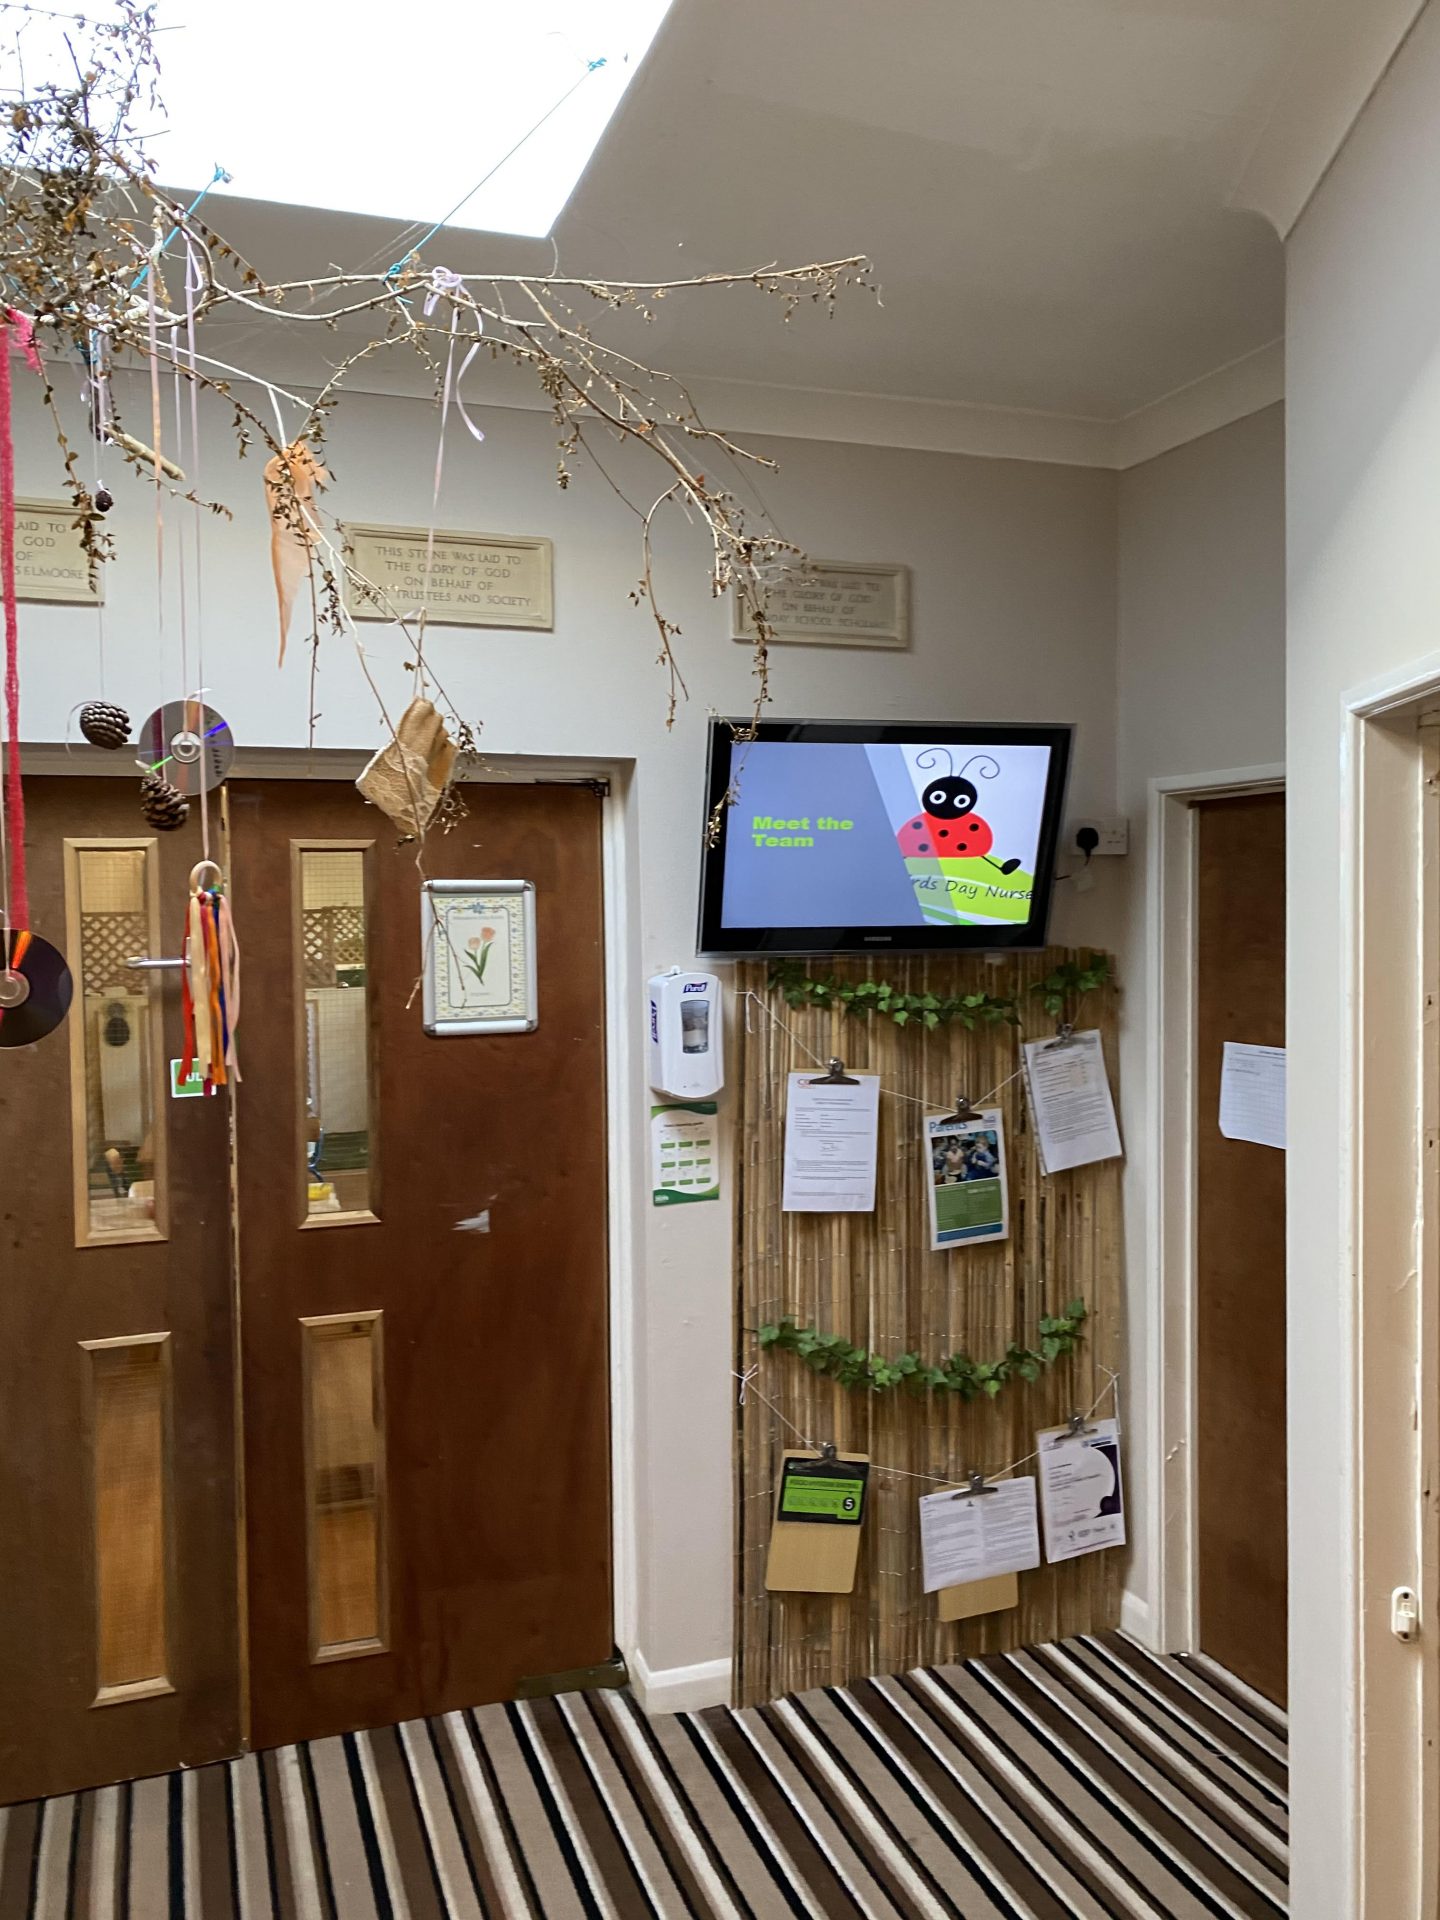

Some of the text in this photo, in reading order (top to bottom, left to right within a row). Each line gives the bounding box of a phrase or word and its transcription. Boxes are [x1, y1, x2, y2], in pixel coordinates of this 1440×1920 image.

[14, 521, 67, 533] AID TO
[23, 536, 56, 547] GOD
[15, 550, 33, 561] OF
[374, 545, 522, 565] THIS STONE WAS LAID TO
[385, 561, 411, 572] THE
[462, 565, 479, 576] OF
[485, 567, 511, 578] GOD
[404, 576, 495, 591] ON BEHALF OF
[457, 594, 481, 604] AND
[486, 595, 532, 607] SOCIETY
[752, 815, 855, 831] Meet the
[751, 833, 815, 848] Team
[910, 875, 937, 890] rds
[945, 879, 978, 900] Day
[845, 1498, 854, 1510] 5
